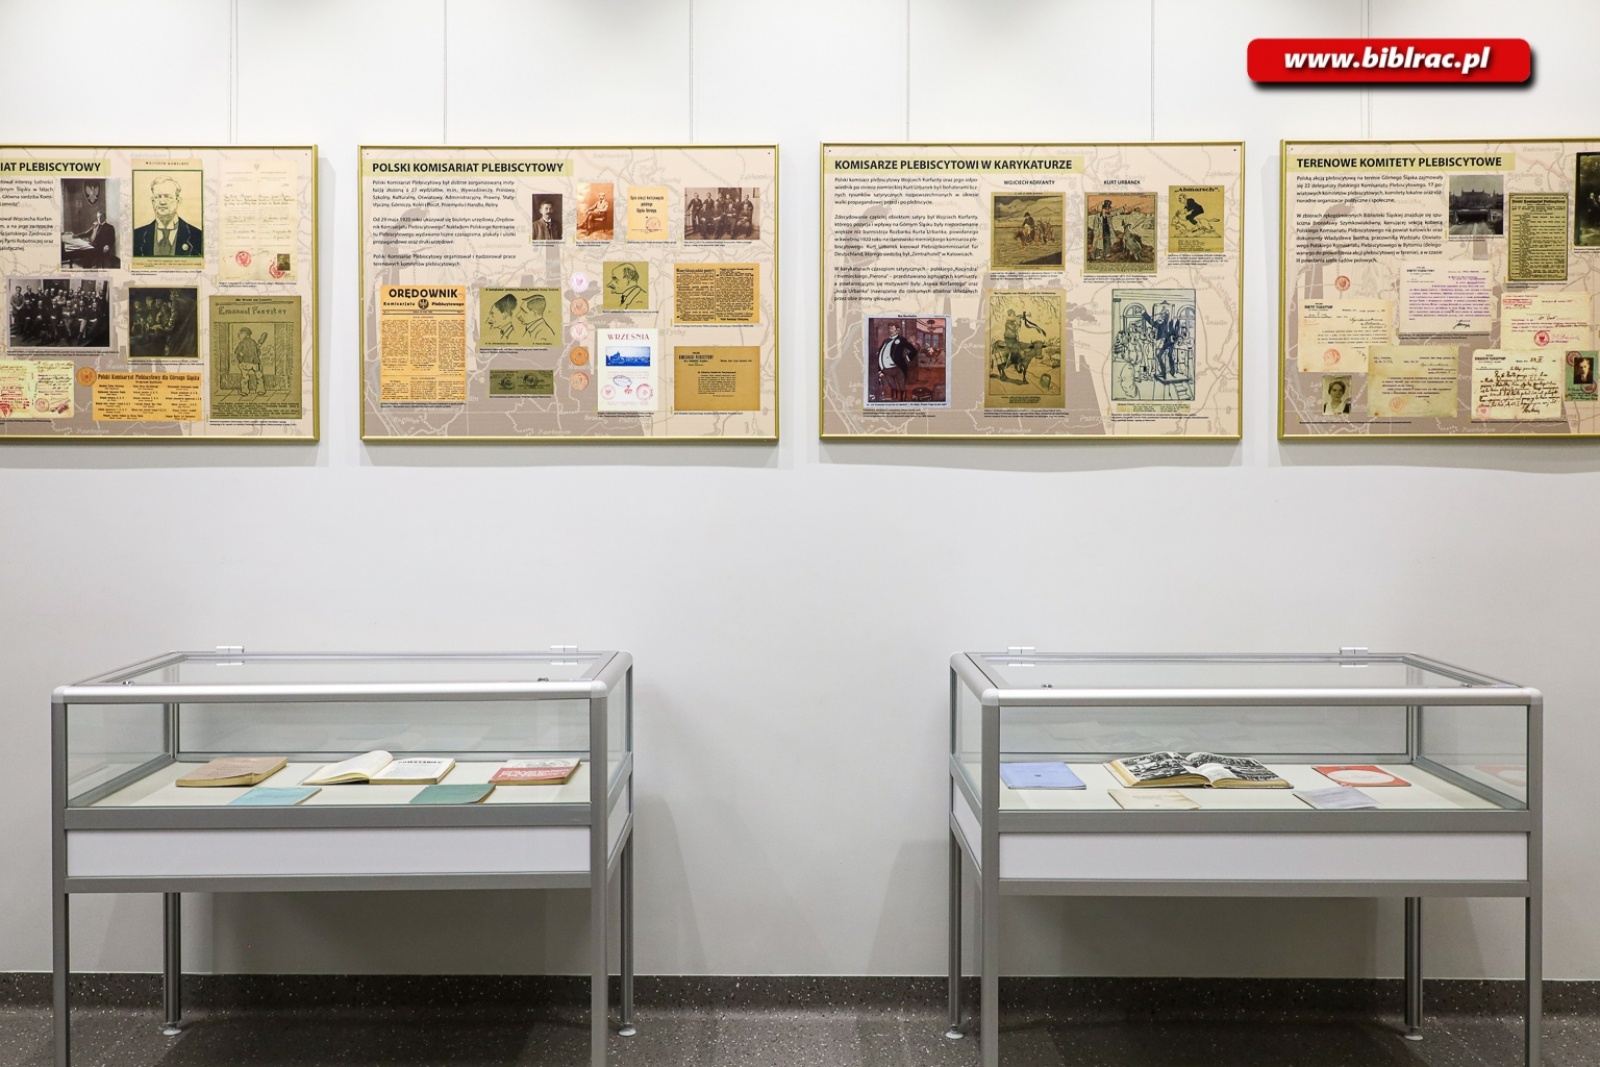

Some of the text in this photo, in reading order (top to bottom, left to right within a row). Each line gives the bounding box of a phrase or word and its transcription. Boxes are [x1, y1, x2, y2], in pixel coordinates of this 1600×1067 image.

[19, 162, 101, 172] PLEBISCYTOWY
[372, 162, 564, 173] POLSKI KOMISARIAT PLEBISCYTOWY
[834, 159, 1073, 170] KOMISARZE PLEBISCYTOWI W KARYKATURZE
[1296, 156, 1502, 168] TERENOWE KOMITETY PLEBISCYTOWE
[388, 288, 458, 299] ORĘDOWNIK
